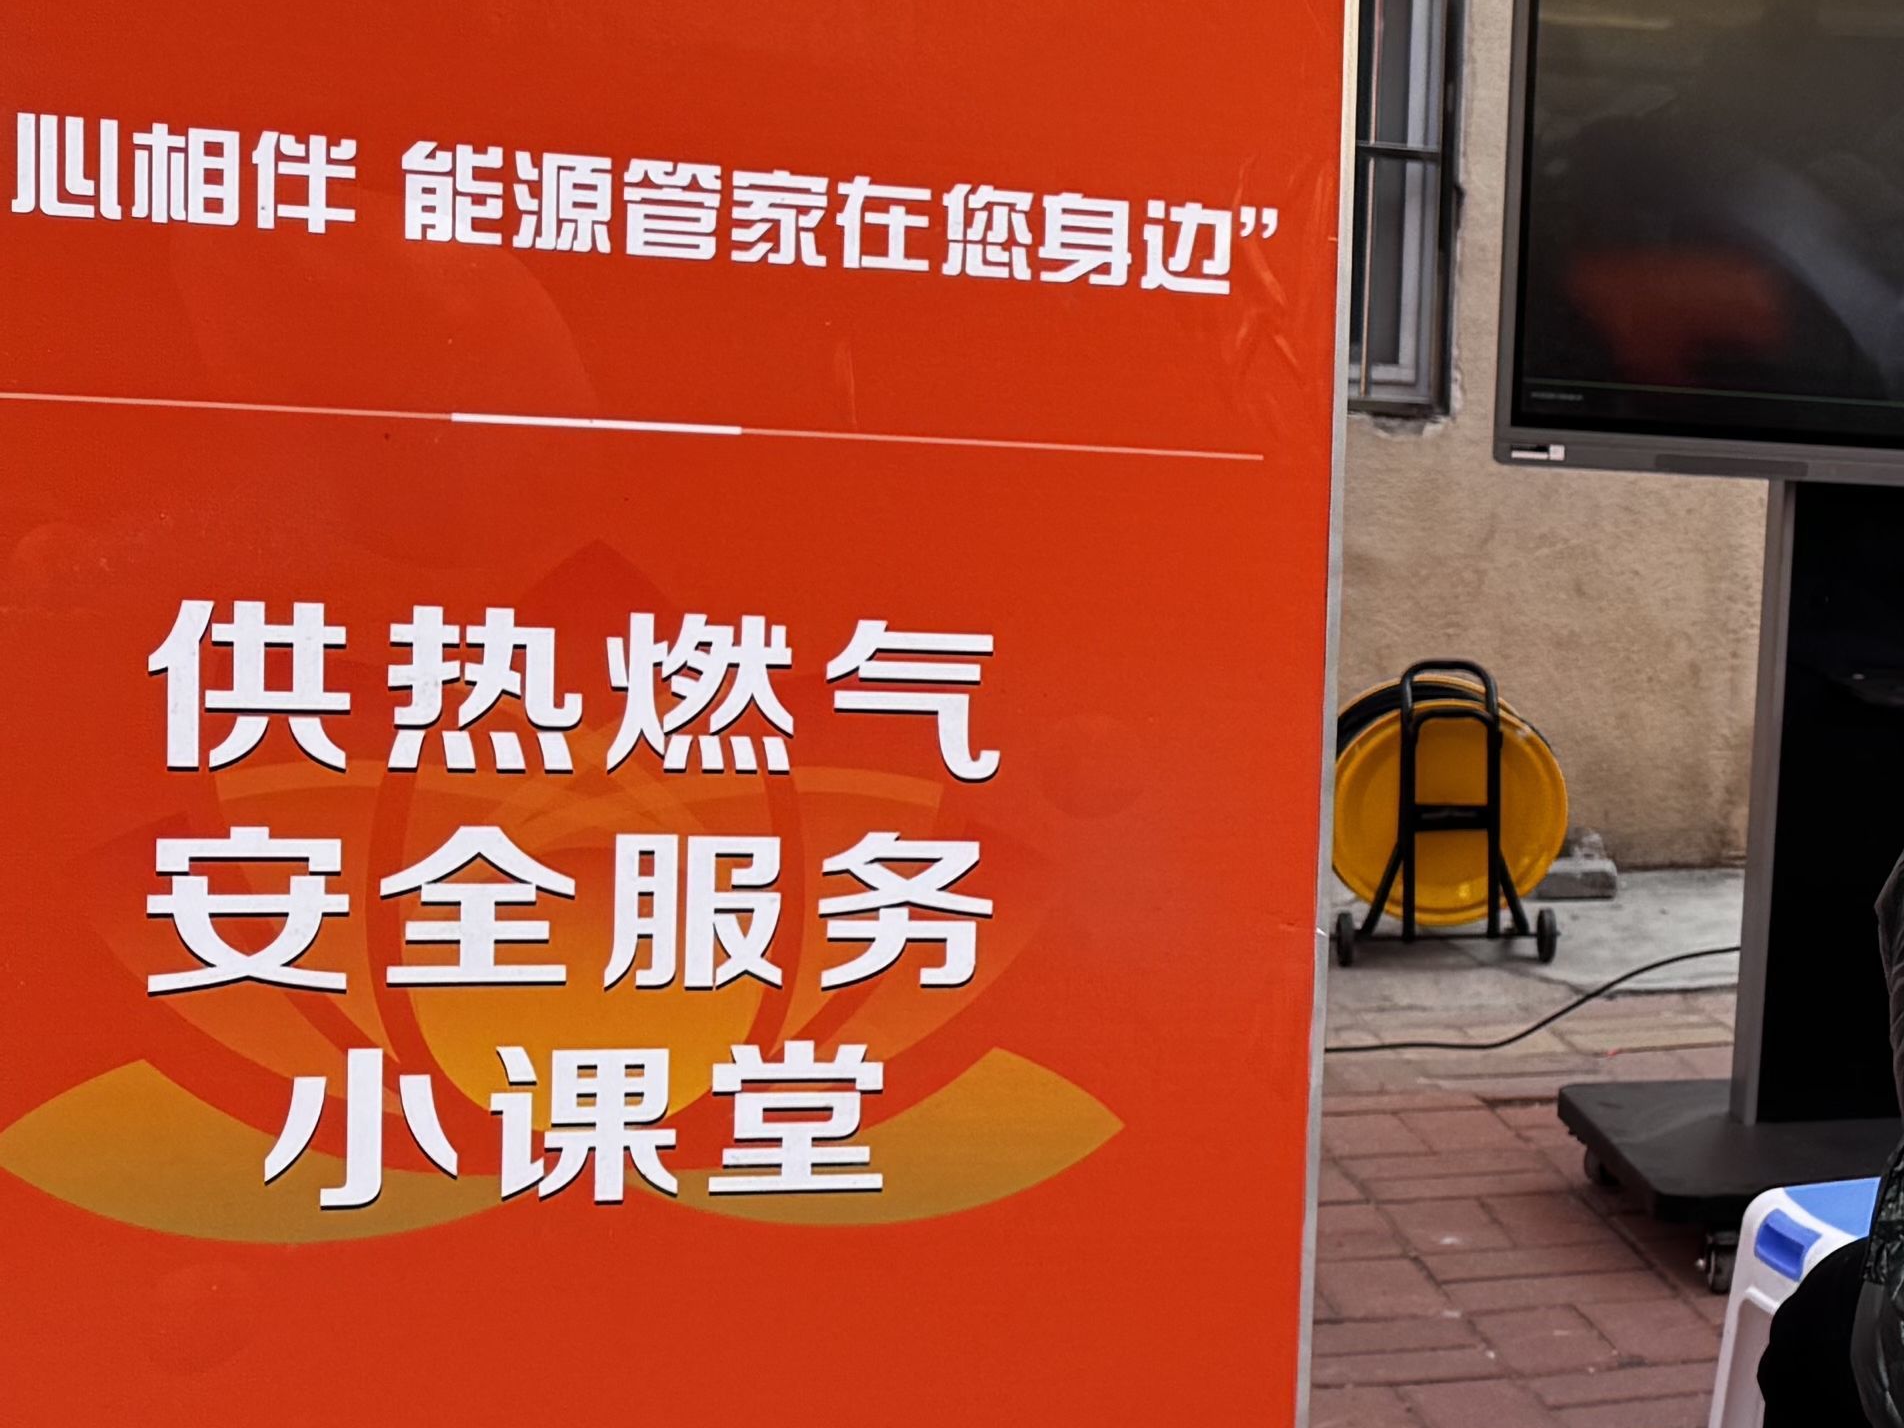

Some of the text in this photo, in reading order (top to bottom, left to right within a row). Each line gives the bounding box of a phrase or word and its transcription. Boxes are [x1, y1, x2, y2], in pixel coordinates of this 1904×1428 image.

[11, 112, 1281, 296] 心相伴 能源管家在您身边”
[148, 600, 1001, 781] 供热燃气
[147, 826, 994, 993] 安全服务
[264, 1040, 884, 1212] 小课堂
